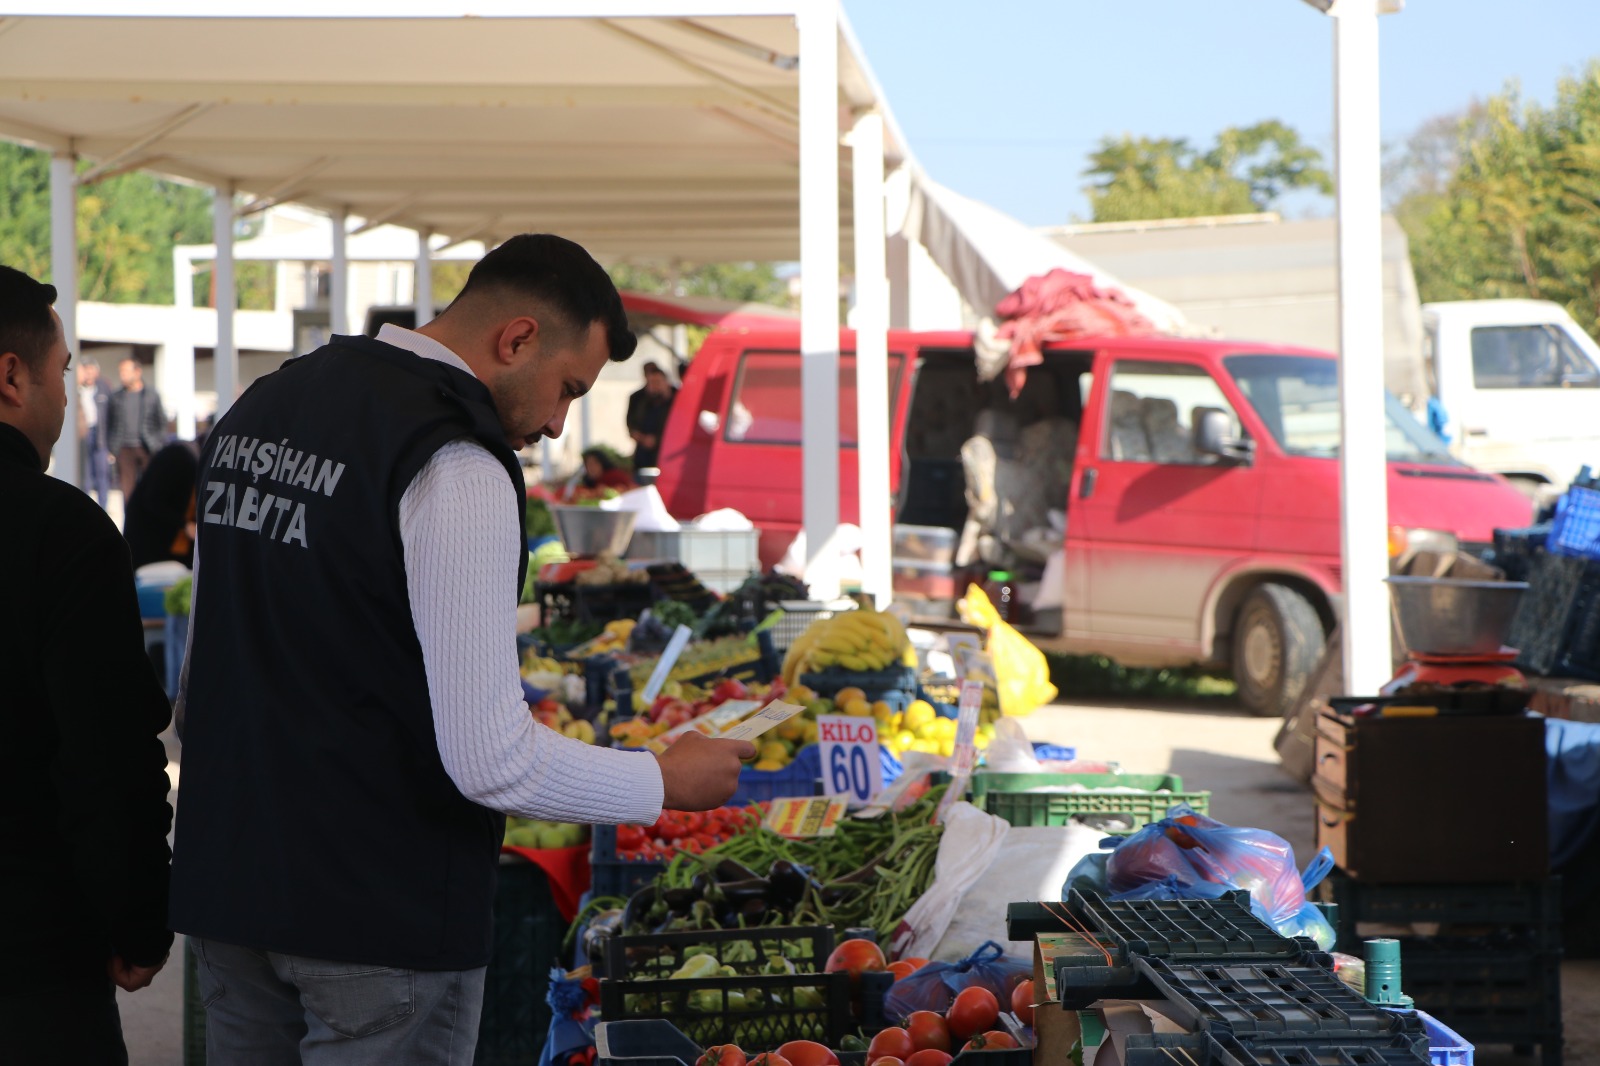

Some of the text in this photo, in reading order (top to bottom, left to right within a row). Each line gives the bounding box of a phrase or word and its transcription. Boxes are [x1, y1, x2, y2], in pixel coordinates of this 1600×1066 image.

[211, 434, 346, 497] YAHŞİHAN
[204, 481, 308, 549] ZABITA
[821, 719, 874, 743] KİLO
[831, 744, 870, 801] 60
